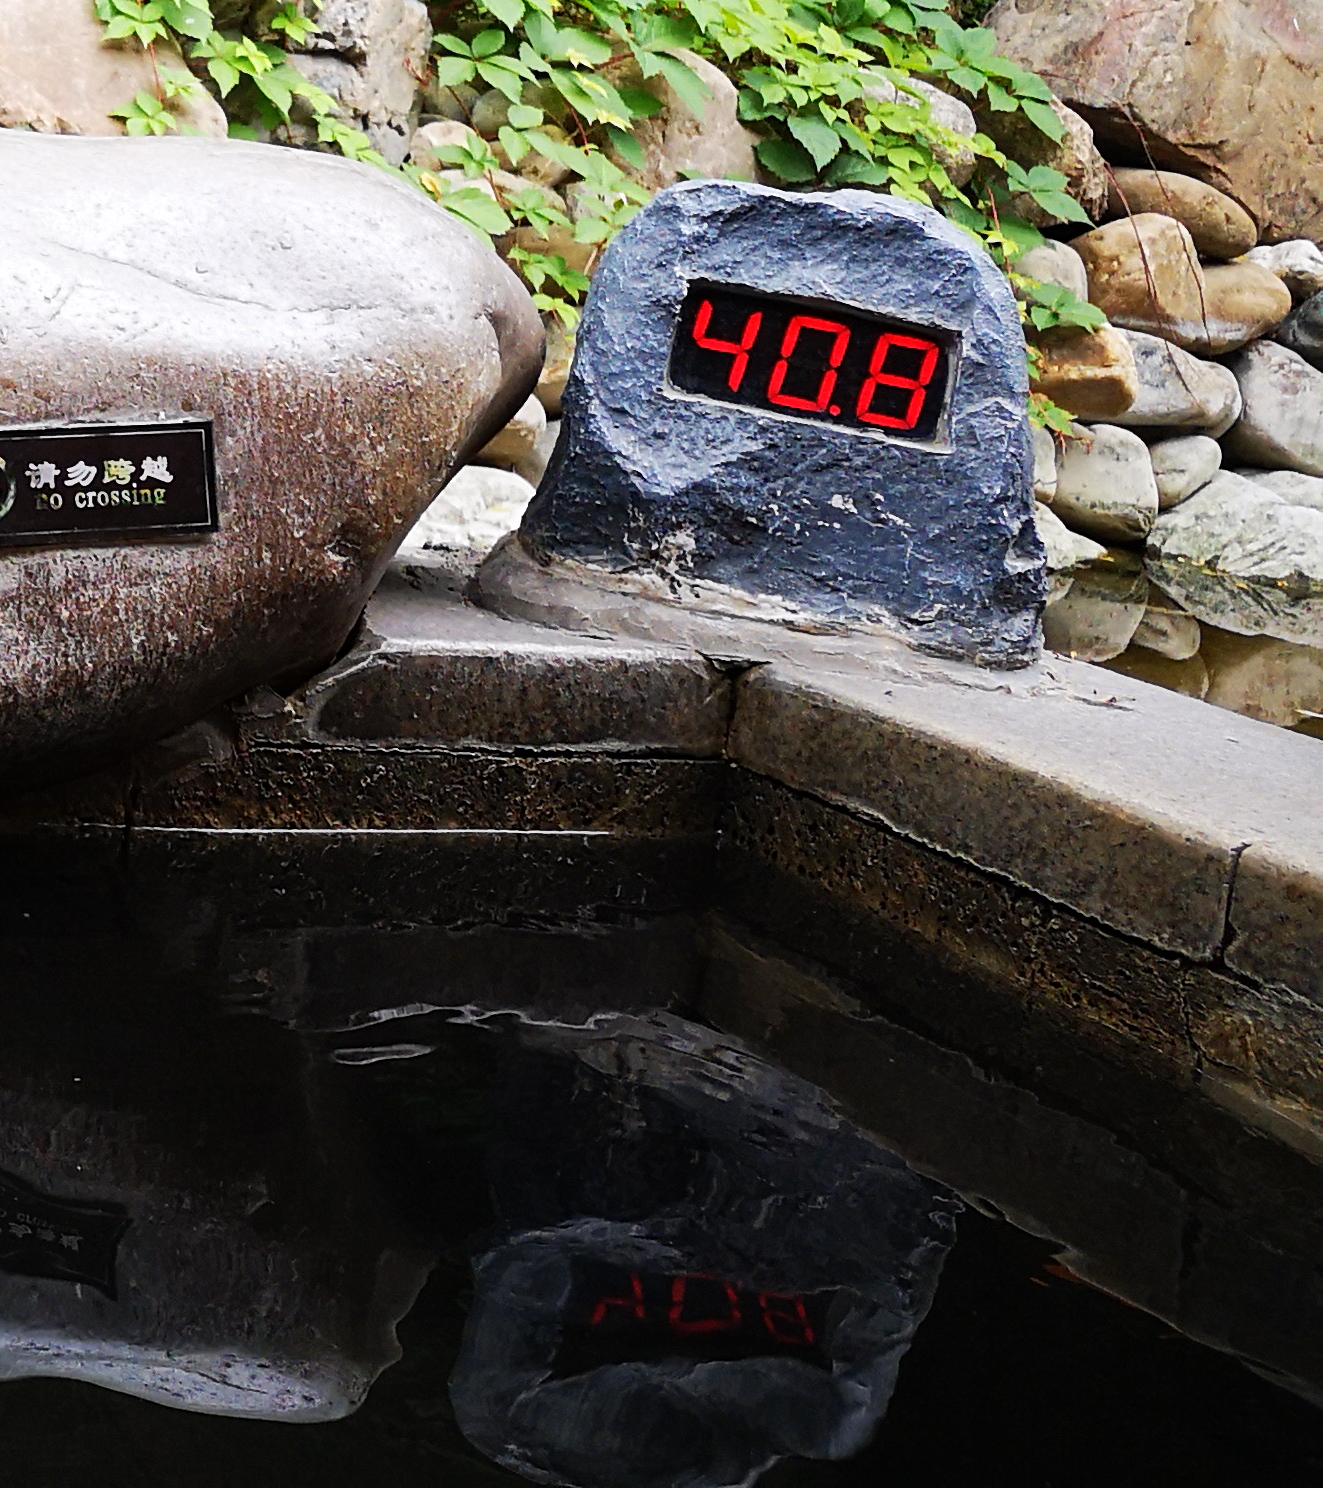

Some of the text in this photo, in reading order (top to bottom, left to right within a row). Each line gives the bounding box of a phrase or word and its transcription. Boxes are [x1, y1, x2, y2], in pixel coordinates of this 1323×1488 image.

[692, 299, 939, 430] 40.8
[24, 455, 174, 490] 请勿跨越
[74, 483, 167, 509] crossing
